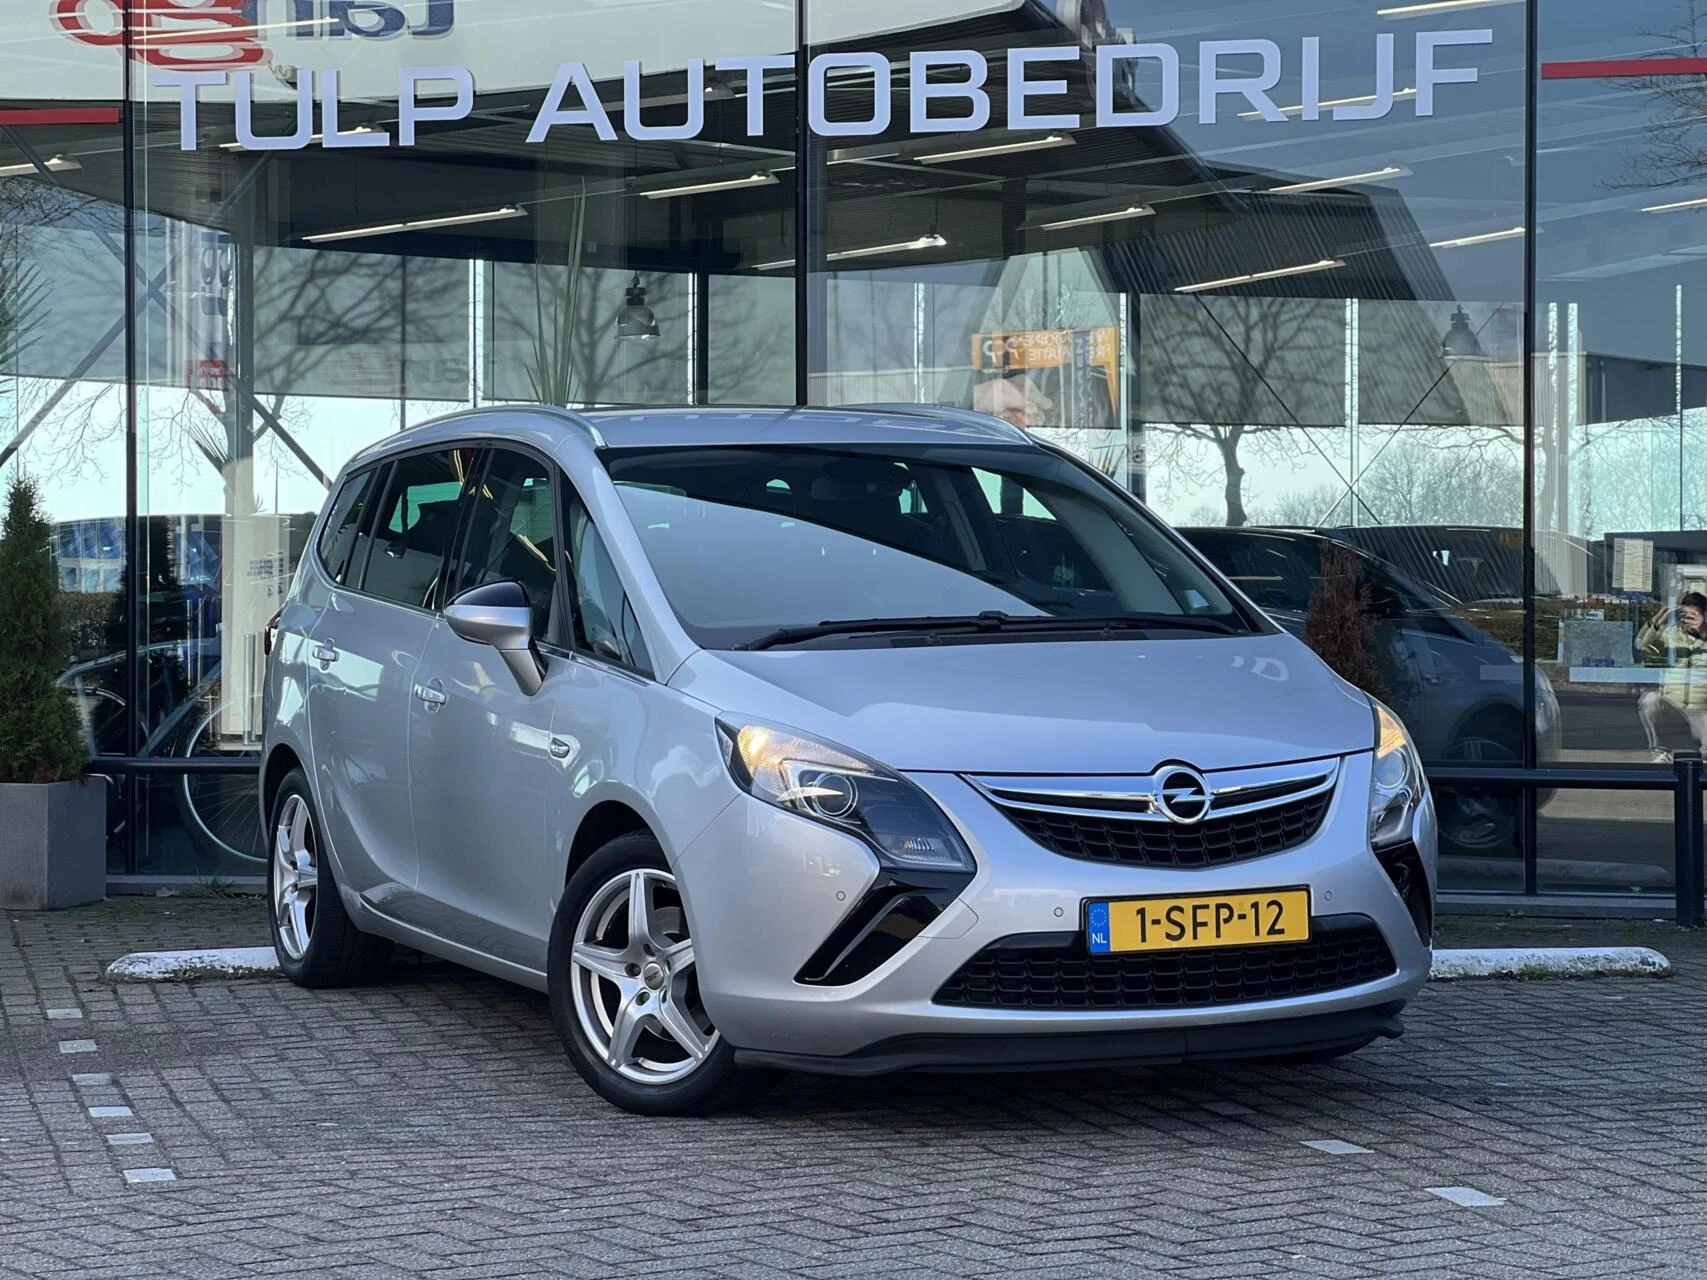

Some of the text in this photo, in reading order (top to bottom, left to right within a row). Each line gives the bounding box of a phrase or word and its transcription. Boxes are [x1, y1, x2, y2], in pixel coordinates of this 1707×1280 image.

[151, 28, 1493, 151] TULP AUTOBEDRIJF
[1091, 899, 1286, 944] NL 1-SFP-12
